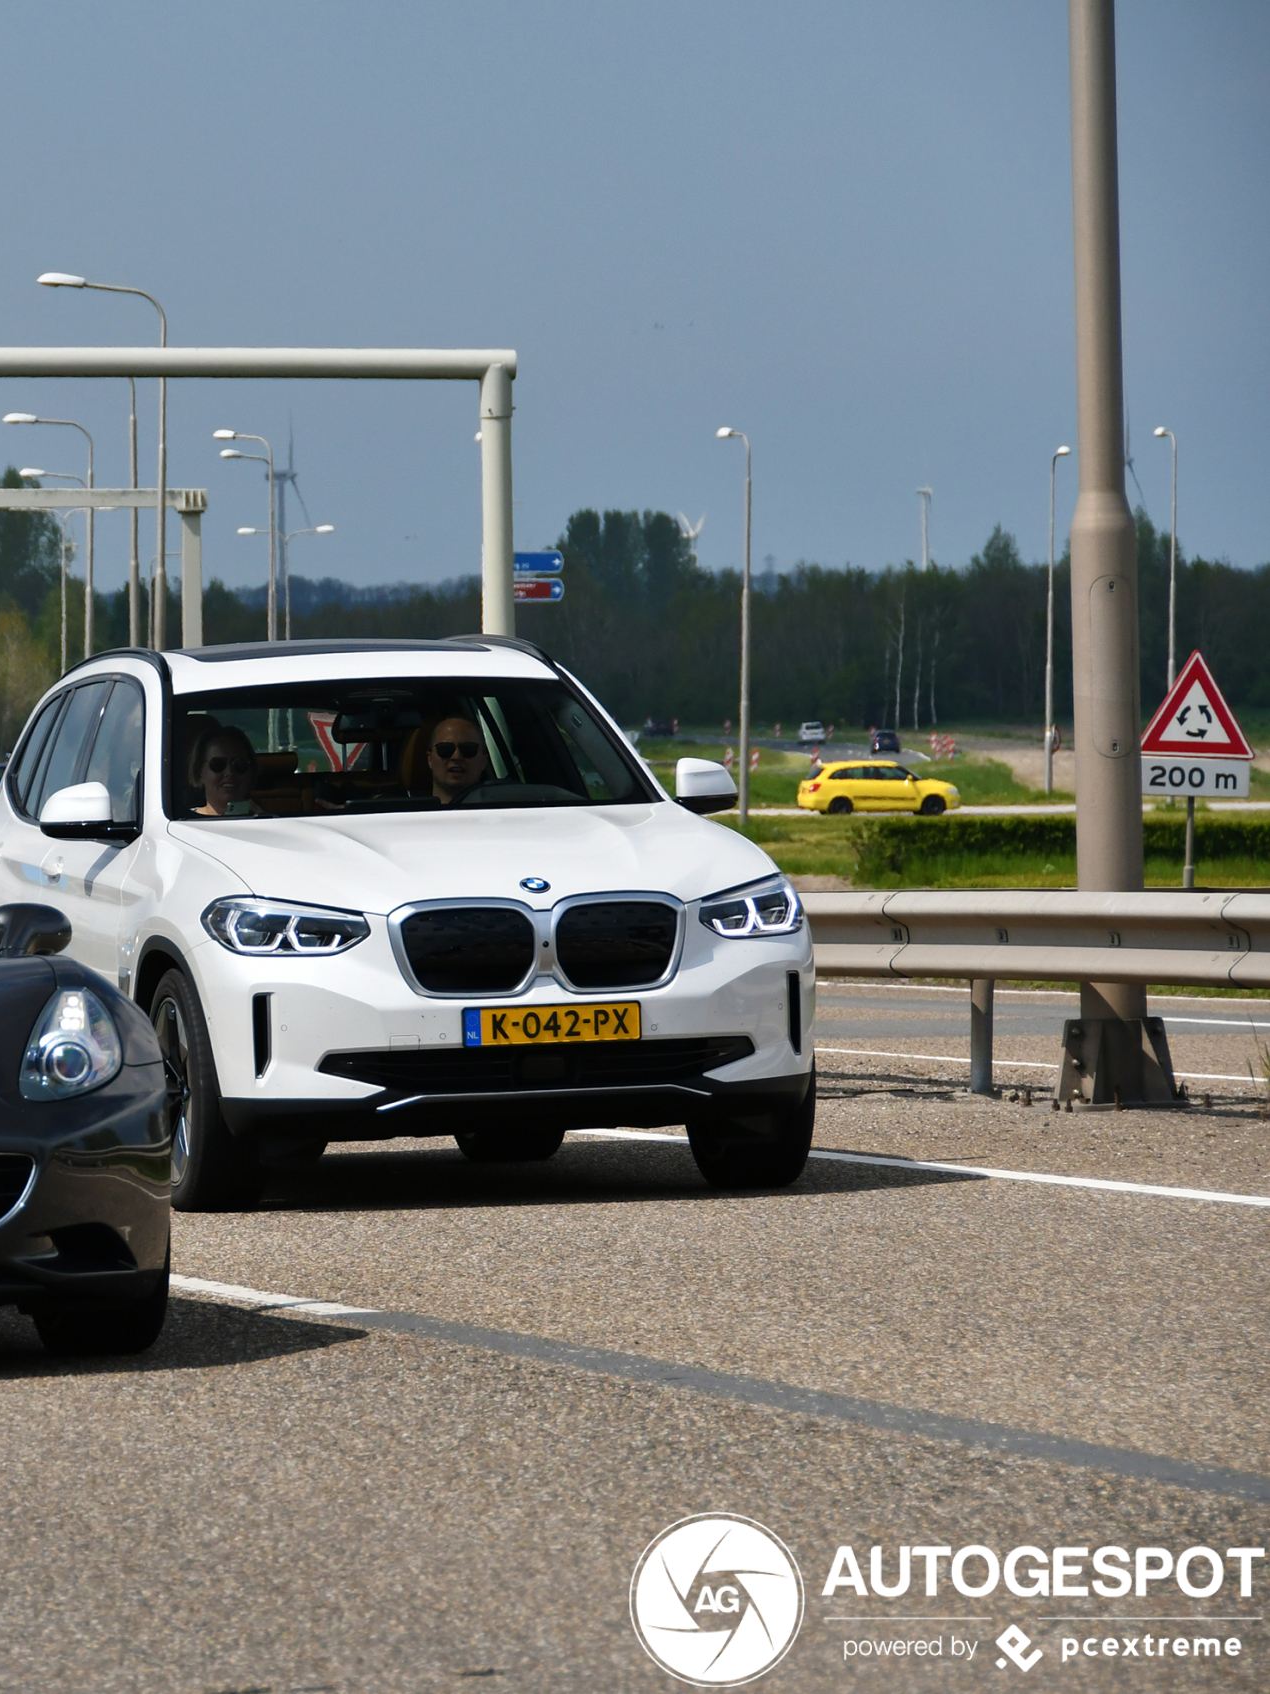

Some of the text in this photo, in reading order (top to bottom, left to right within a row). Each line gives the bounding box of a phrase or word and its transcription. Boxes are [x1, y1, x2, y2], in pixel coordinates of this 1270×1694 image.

[1149, 765, 1237, 790] 200 m
[467, 1007, 630, 1040] NL K-042-PX
